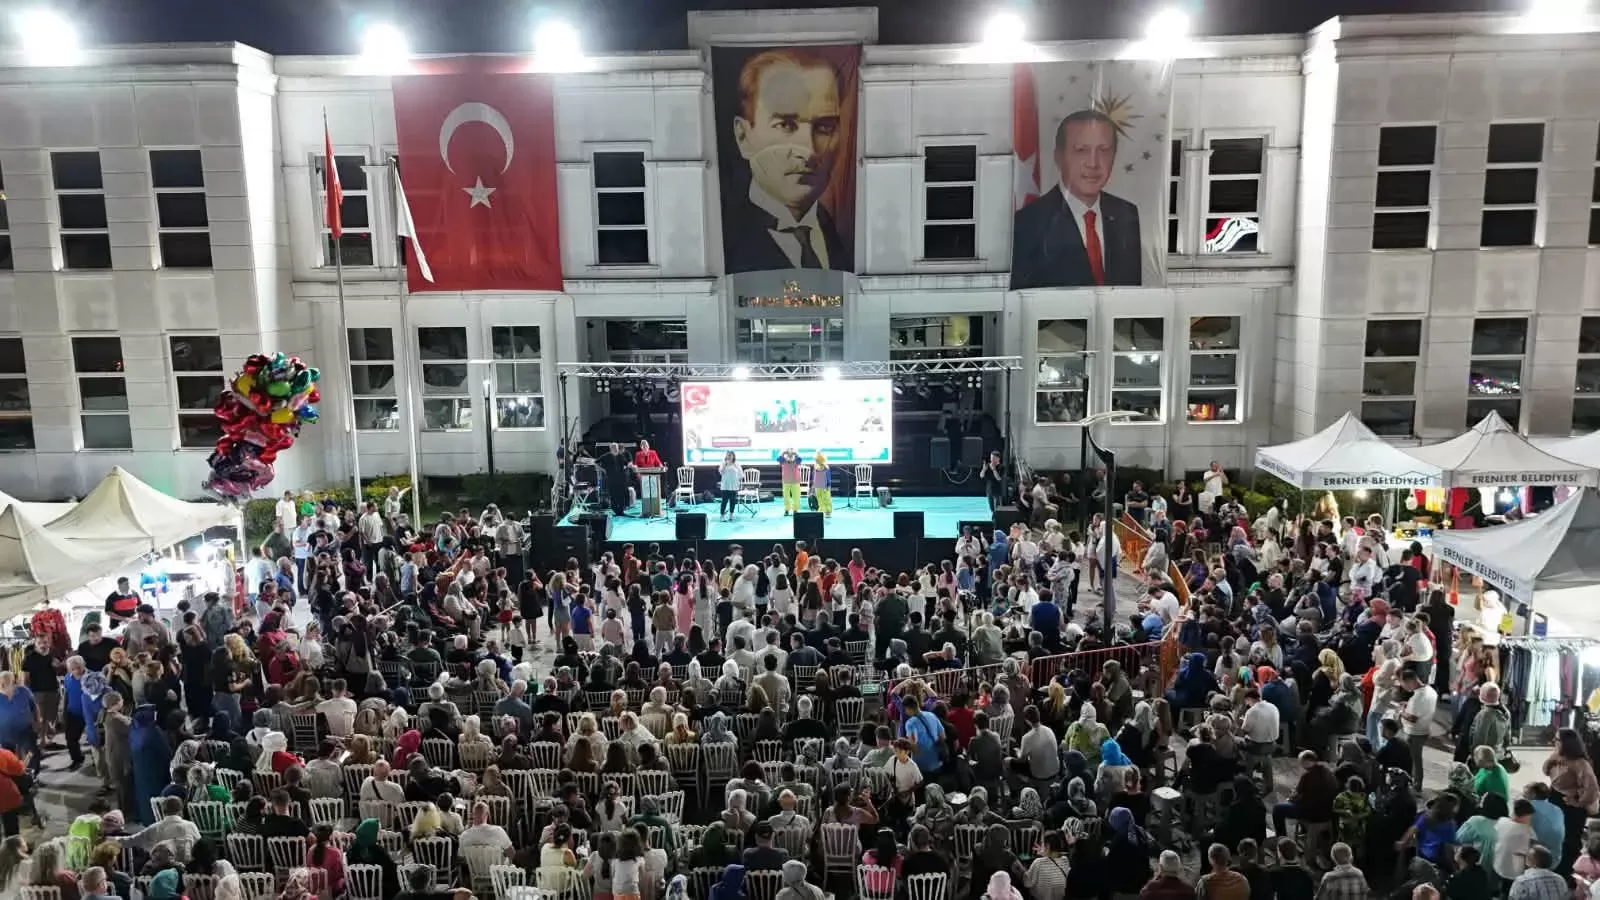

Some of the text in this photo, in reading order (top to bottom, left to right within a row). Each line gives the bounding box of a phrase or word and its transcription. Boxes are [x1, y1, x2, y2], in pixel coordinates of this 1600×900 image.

[1323, 477, 1368, 486] ERENLER
[1471, 475, 1518, 484] ERENLER
[1443, 547, 1474, 569] ERENLER
